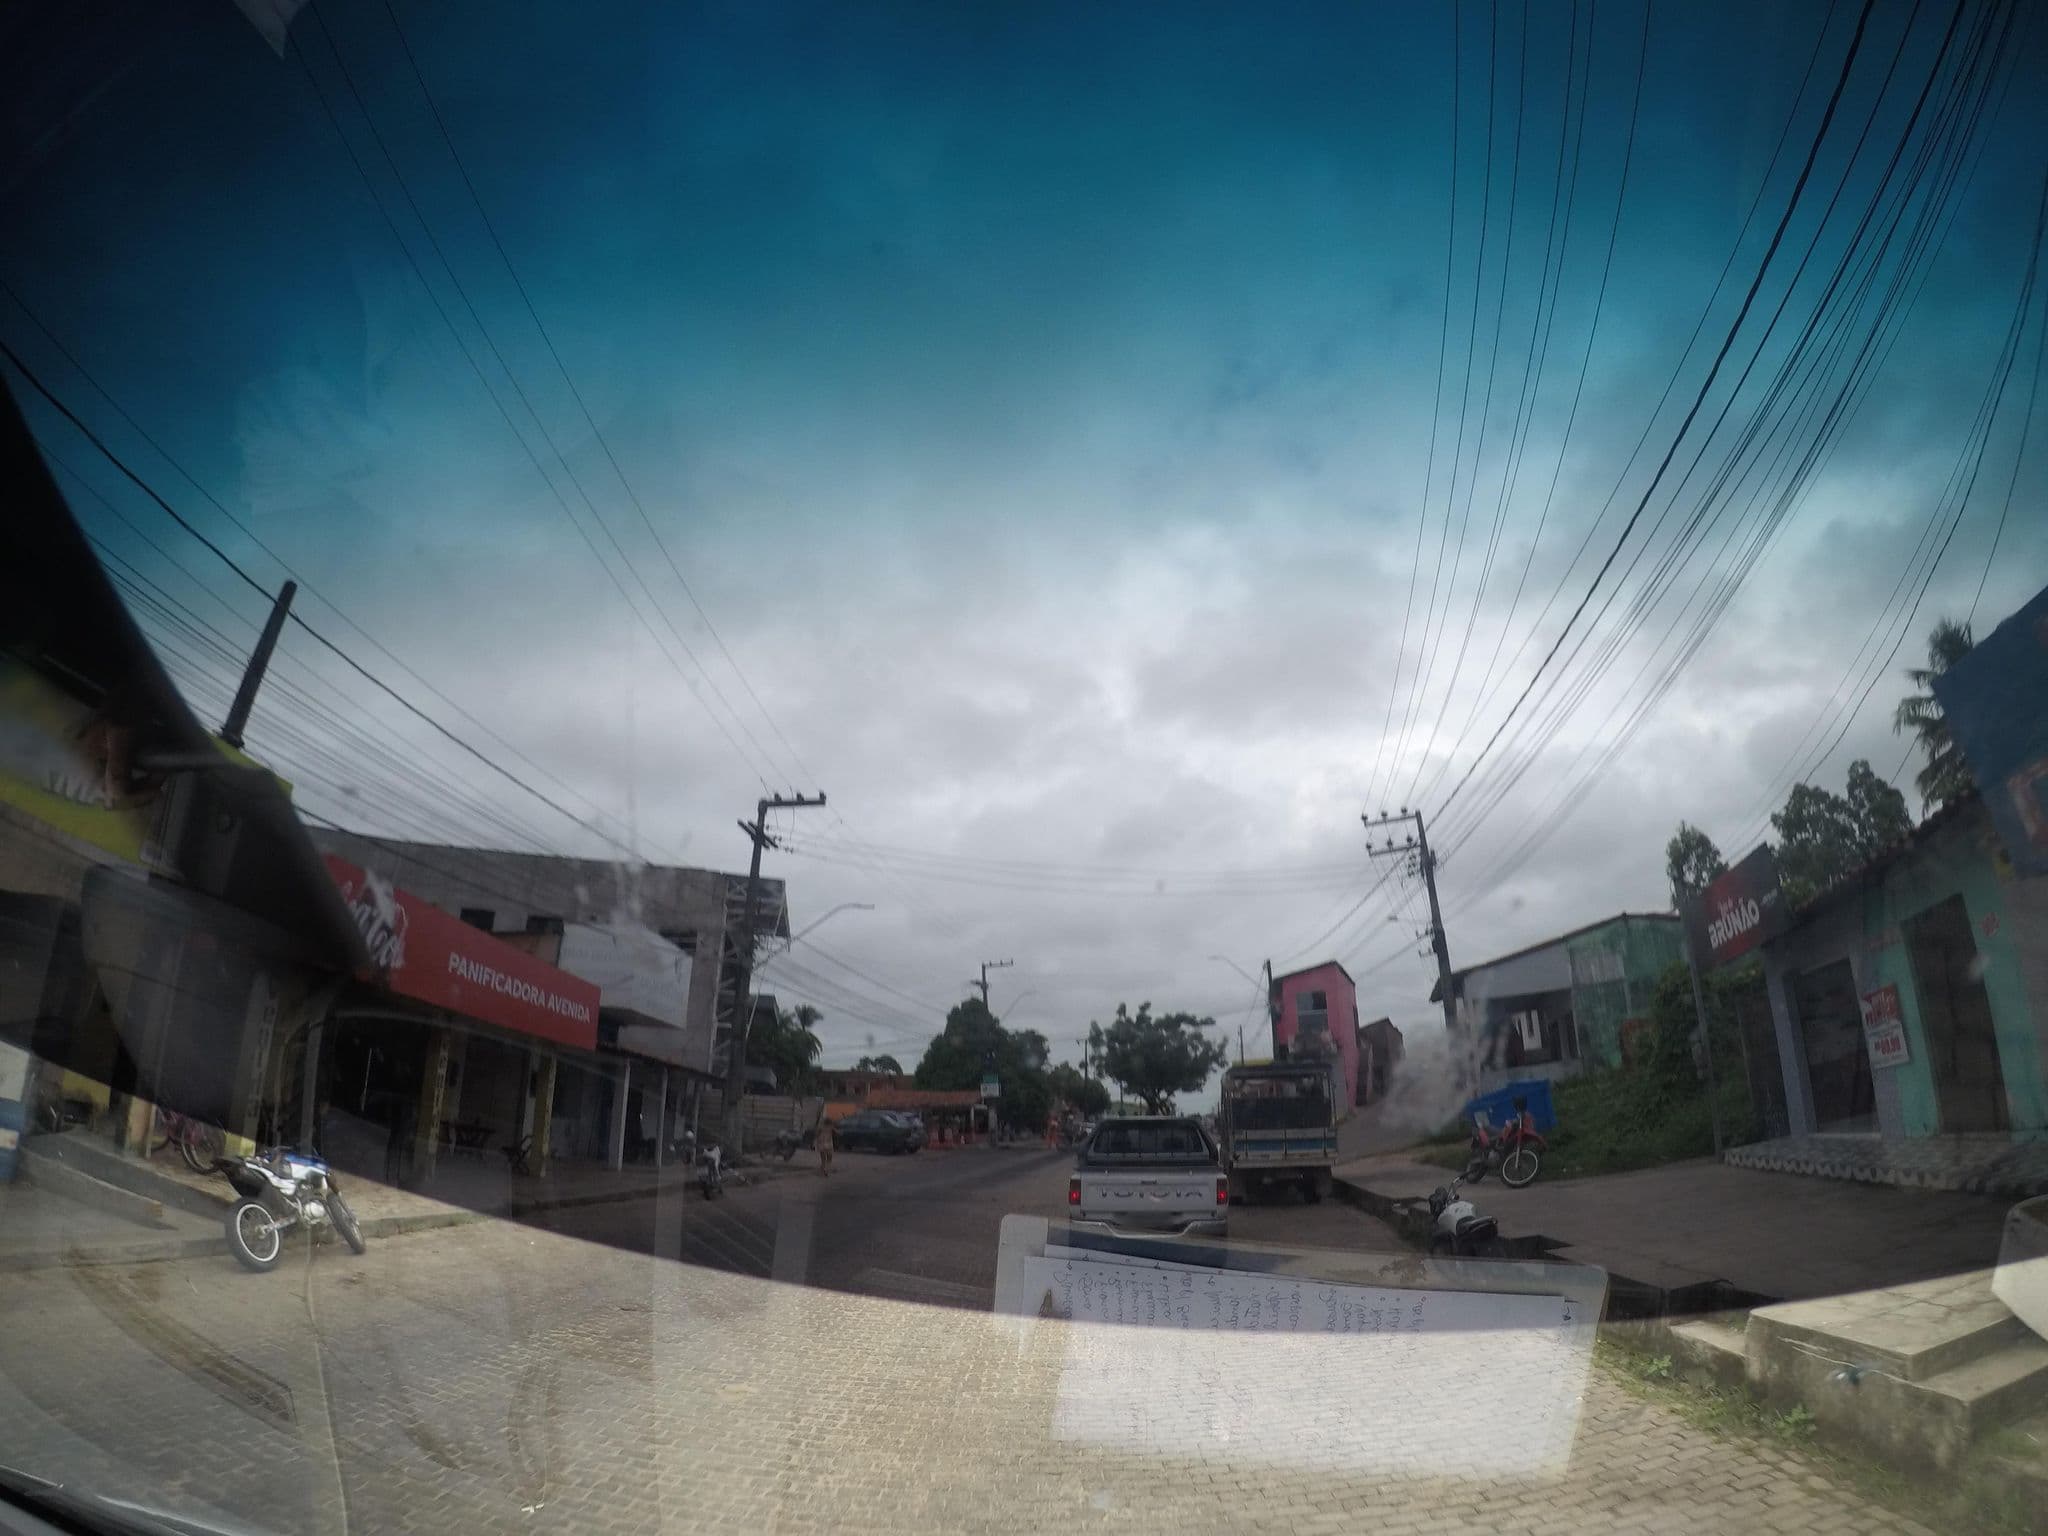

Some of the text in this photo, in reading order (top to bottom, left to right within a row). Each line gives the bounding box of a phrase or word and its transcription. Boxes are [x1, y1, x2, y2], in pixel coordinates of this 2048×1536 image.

[1708, 896, 1760, 949] BRUNÃO
[447, 953, 546, 1008] PANIFICADORA
[547, 994, 591, 1024] AVENIDA
